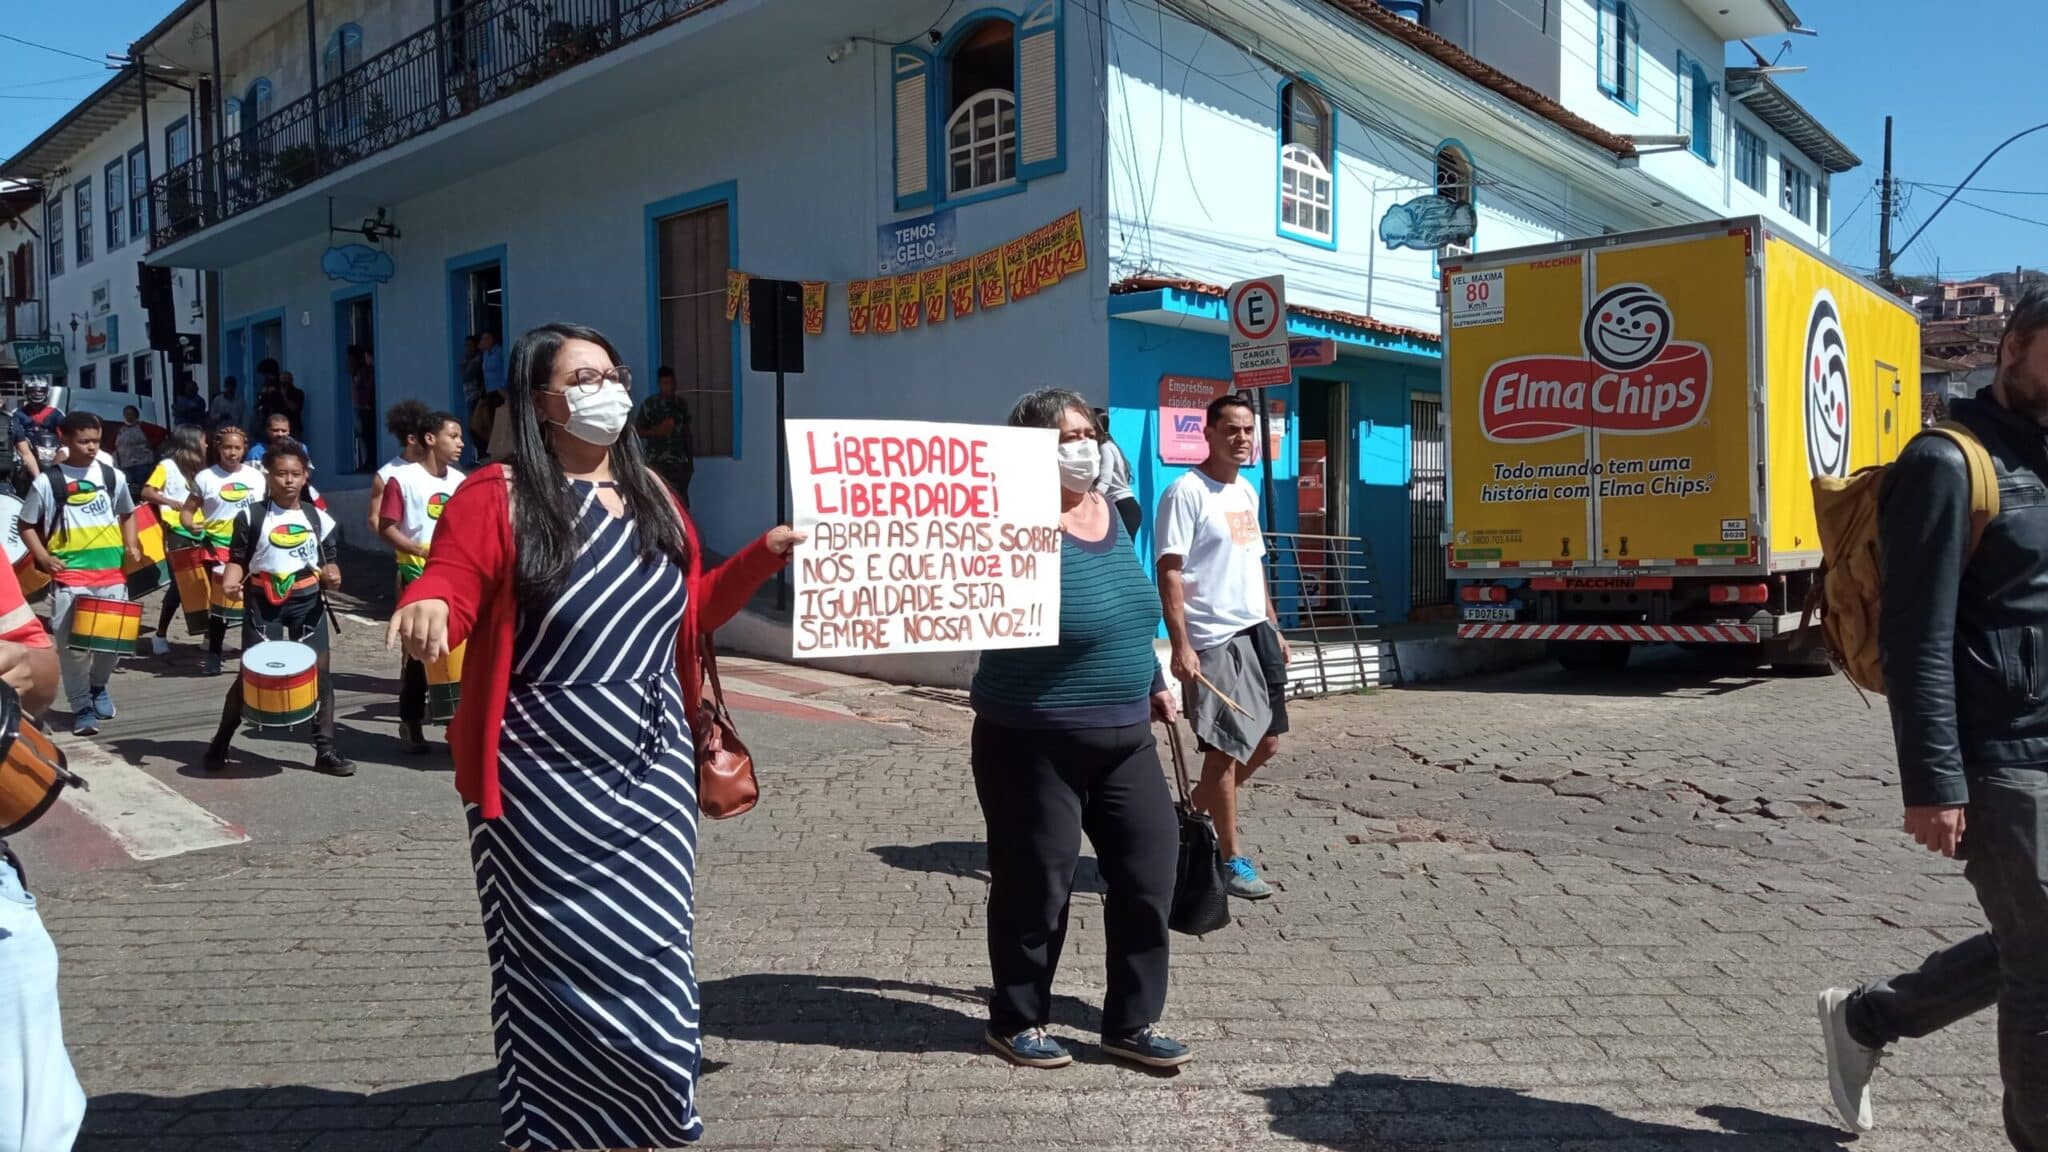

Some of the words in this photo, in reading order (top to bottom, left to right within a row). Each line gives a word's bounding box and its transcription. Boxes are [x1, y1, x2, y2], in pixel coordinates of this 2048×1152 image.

[895, 223, 936, 245] TEMOS
[896, 239, 936, 263] GELO
[1530, 256, 1582, 270] FACCHINI
[1466, 282, 1489, 302] 80
[1248, 296, 1265, 326] E
[1240, 357, 1281, 369] DESCARGA
[1243, 349, 1270, 360] CARGA
[1494, 372, 1587, 416] Elma
[1592, 373, 1697, 422] Chips
[1494, 461, 1534, 480] Todo
[1537, 458, 1604, 478] mundo
[1609, 459, 1643, 475] tem
[1648, 456, 1691, 472] uma
[1481, 482, 1549, 503] história
[1553, 484, 1590, 500] com
[1599, 480, 1645, 498] Elma
[814, 520, 881, 551] ABRA
[888, 520, 919, 548] AS
[926, 520, 993, 552] ASAS
[999, 523, 1060, 553] SOBRE
[803, 552, 855, 584] NÓS
[867, 554, 883, 581] E
[889, 552, 937, 581] QUE
[940, 552, 957, 581] A
[961, 555, 1003, 578] VOZ
[1011, 554, 1037, 581] DA
[1566, 578, 1636, 589] FACCHINI
[800, 584, 944, 621] IGUALDADE
[949, 582, 1005, 611] SEJA
[798, 618, 890, 651] SEMPRE
[903, 614, 973, 645] NOSSA
